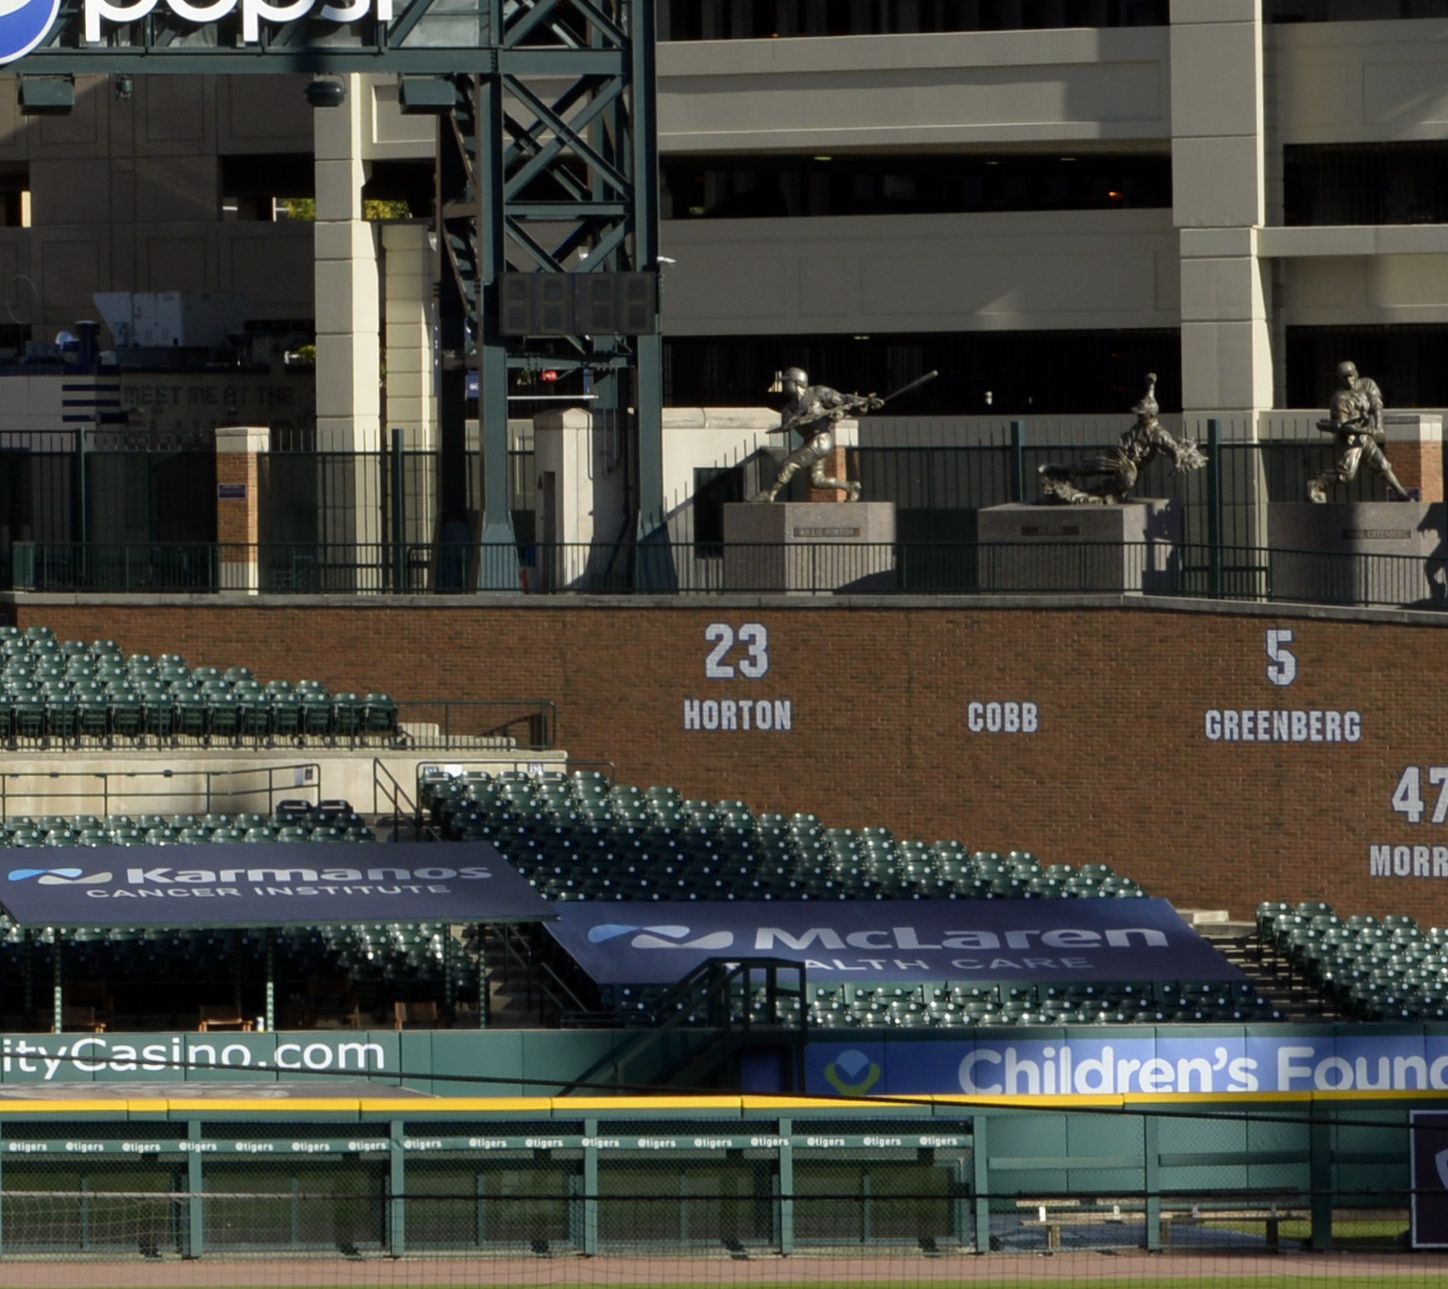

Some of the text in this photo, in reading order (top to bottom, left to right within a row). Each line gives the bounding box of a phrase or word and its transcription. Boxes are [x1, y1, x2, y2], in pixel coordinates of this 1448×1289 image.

[124, 385, 181, 406] MEET
[189, 385, 218, 406] ME
[224, 385, 249, 406] AT
[704, 622, 769, 679] 23
[1266, 629, 1297, 686] 5
[684, 699, 792, 731] HORTON
[968, 702, 1038, 733] COBB
[1205, 709, 1362, 742] GREENBERG
[1391, 766, 1448, 824] 47
[126, 866, 493, 884] Karmanos
[86, 885, 451, 899] CANCER INSTITUTE
[754, 925, 1168, 950] McLaren
[951, 957, 1095, 971] CARE
[958, 1045, 1260, 1095] Children's
[9, 1140, 47, 1152] @tigers
[65, 1141, 103, 1153] @tigers
[122, 1141, 160, 1153] @tigers
[179, 1141, 217, 1153] @tigers
[235, 1141, 273, 1153] @tigers
[292, 1141, 330, 1153] @tigers
[348, 1140, 386, 1152] @tigers
[404, 1139, 442, 1151] @tigers
[807, 1136, 845, 1148] @tigers
[863, 1136, 901, 1148] @tigers
[920, 1135, 957, 1147] @tigers
